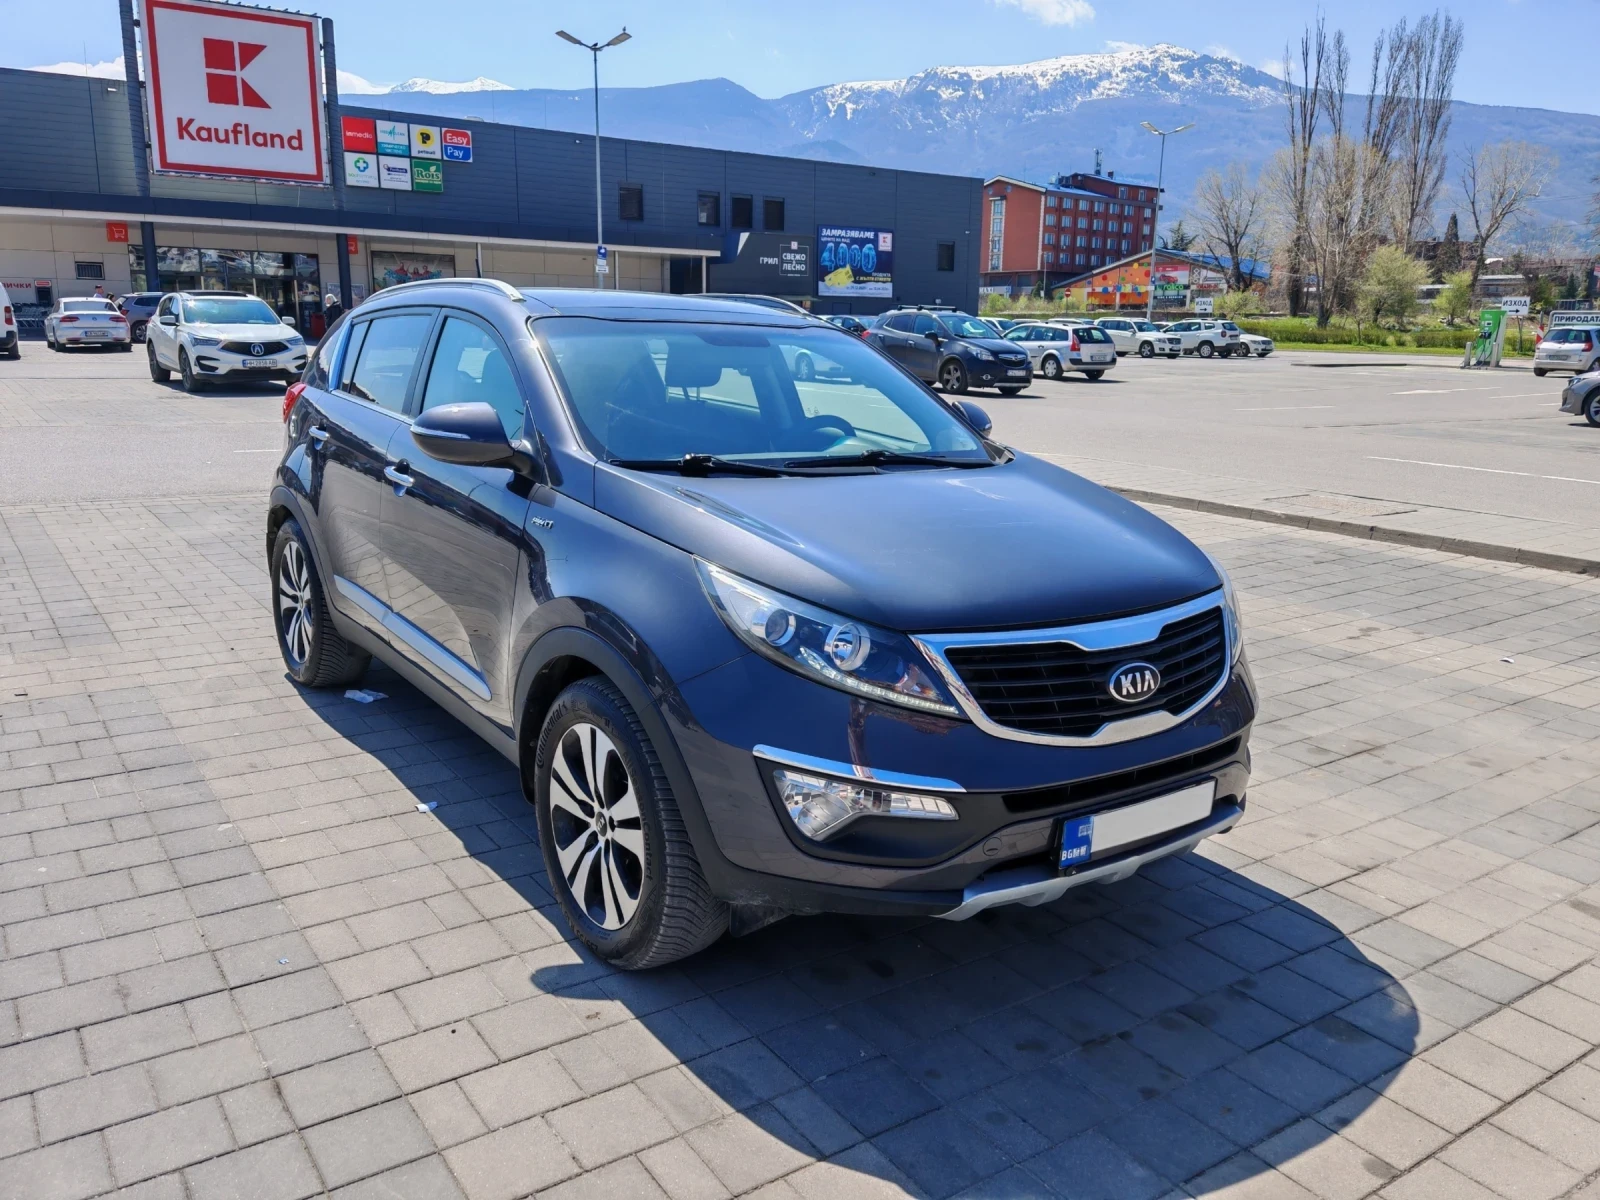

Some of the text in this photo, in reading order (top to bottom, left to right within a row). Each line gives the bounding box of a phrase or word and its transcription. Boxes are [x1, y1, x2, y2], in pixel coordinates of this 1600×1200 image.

[176, 117, 304, 151] Kaufland
[446, 133, 468, 146] Easy
[447, 147, 464, 158] Pay
[414, 168, 441, 180] Rois
[821, 228, 875, 239] ЗАМРАЗЯВАМЕ
[760, 257, 778, 265] ГРИЛ
[782, 253, 806, 261] СВЕЖО
[821, 242, 877, 273] 4000
[782, 263, 806, 271] ЛЕСНО
[1502, 299, 1528, 307] ИЗХОД
[1554, 315, 1600, 323] ПРИРОДАТ
[1120, 670, 1155, 696] KIA
